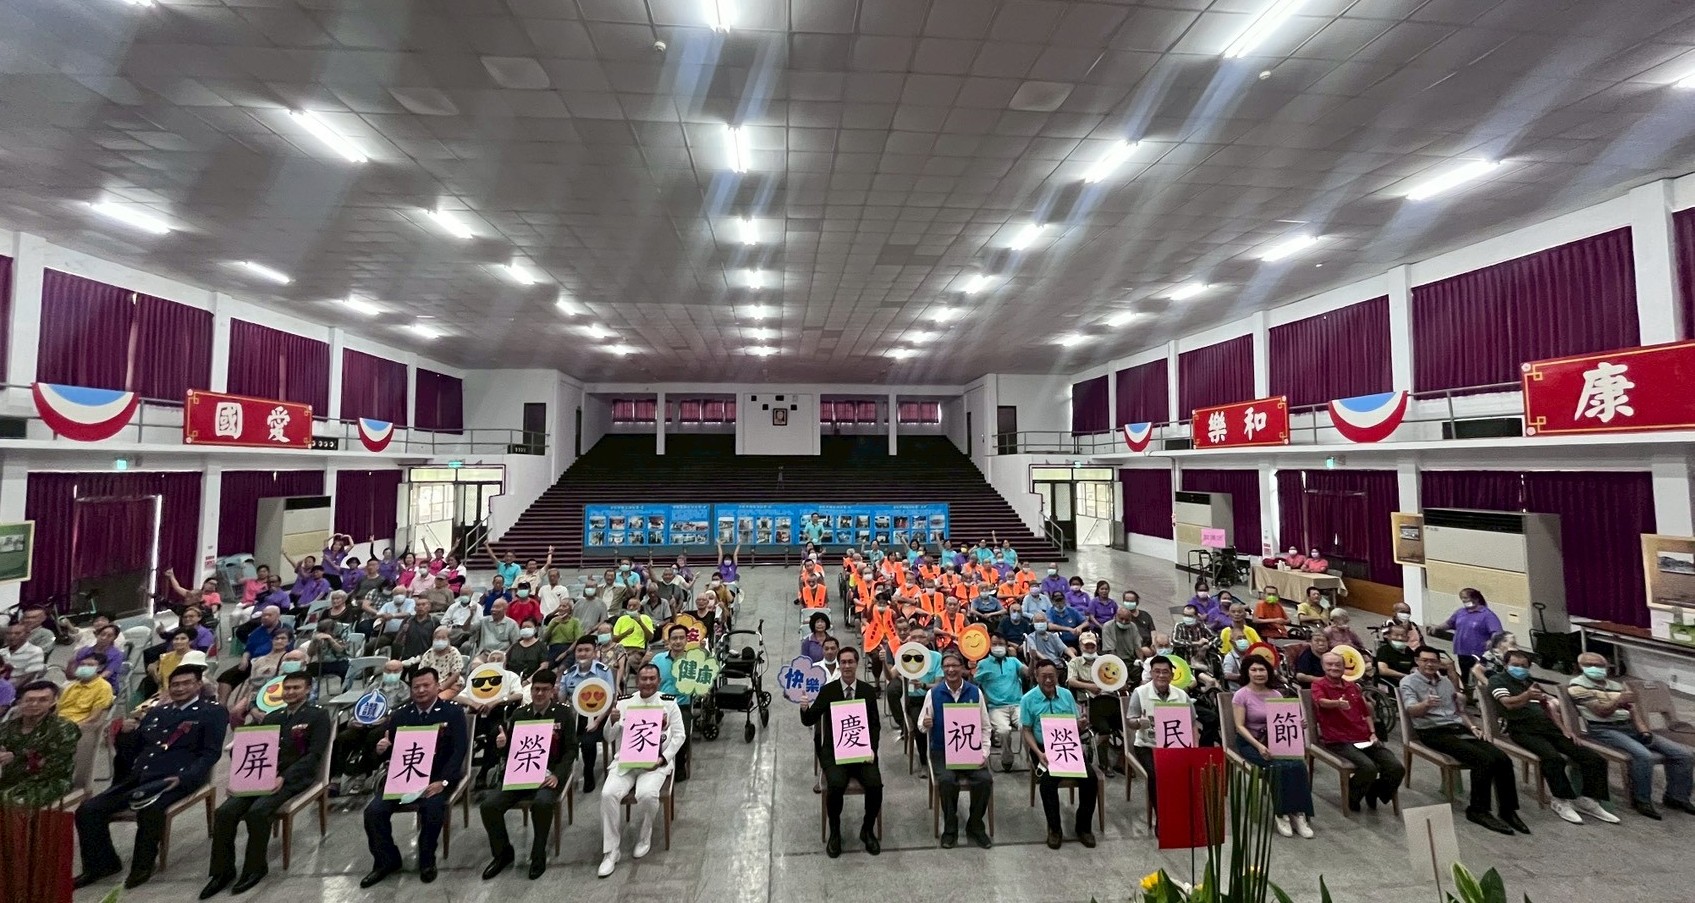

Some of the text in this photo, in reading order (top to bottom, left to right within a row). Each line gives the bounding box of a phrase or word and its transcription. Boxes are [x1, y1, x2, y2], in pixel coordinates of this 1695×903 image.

[1574, 361, 1635, 423] 康
[678, 659, 713, 685] 健康
[784, 668, 820, 693] 快樂
[629, 718, 659, 753] 家
[836, 714, 869, 748] 慶
[947, 721, 982, 753] 祝
[1050, 728, 1081, 764] 榮
[1163, 719, 1192, 748] 民
[1273, 712, 1298, 748] 節
[235, 743, 272, 780] 屏
[392, 741, 430, 783] 東
[513, 734, 547, 774] 榮
